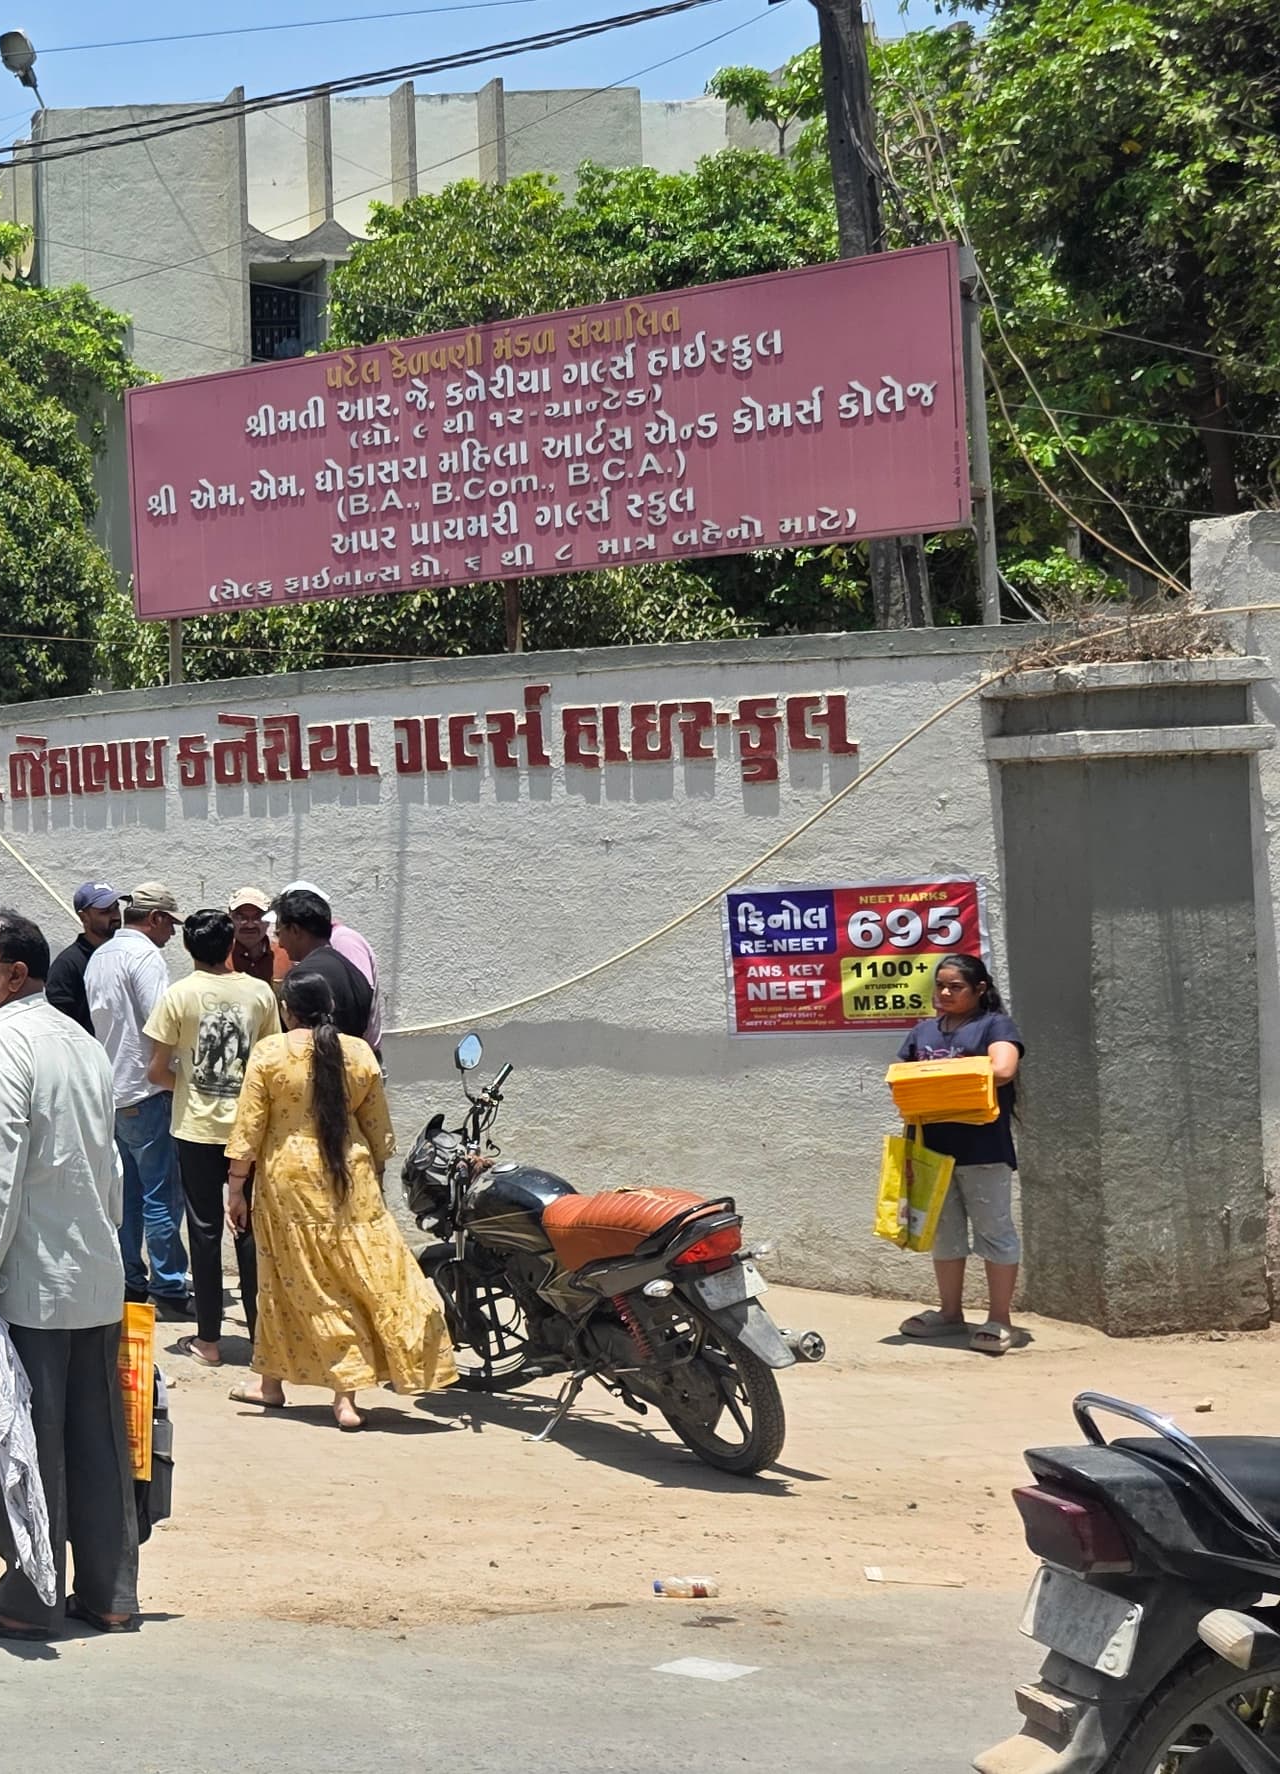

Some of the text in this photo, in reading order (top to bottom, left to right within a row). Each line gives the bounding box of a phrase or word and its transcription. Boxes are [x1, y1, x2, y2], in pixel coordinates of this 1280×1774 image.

[326, 304, 681, 390] પટેલ કેળવણી મંડળ સંચાલિત
[245, 396, 327, 438] શ્રીમતી
[337, 394, 399, 424] આર.
[405, 379, 435, 412] જે.
[445, 365, 552, 407] કનેરીયા
[442, 410, 476, 435] થી
[146, 484, 178, 518] શ્રી
[190, 479, 245, 512] એમ.
[250, 470, 306, 503] એમ.
[438, 438, 529, 475] મહિલા
[644, 409, 719, 447] એન્ડ
[732, 385, 825, 436] કોમર્સ
[837, 375, 938, 421] કોલેજ
[336, 449, 687, 522] (B.A., B.Com., B.C.A.)
[331, 526, 397, 556] અપર
[410, 500, 521, 548] પ્રાયમરી
[625, 486, 697, 527] સ્કુલ
[500, 543, 534, 568] થી
[597, 532, 658, 556] માત્ર
[671, 515, 765, 548] બહેનો
[176, 711, 380, 787] કનેરીયા
[859, 891, 948, 905] NEET MARKS
[740, 937, 828, 954] RE-NEET
[848, 906, 962, 949] 695
[746, 963, 825, 978] ANS. KEY
[747, 980, 826, 1001] NEET
[851, 961, 928, 978] 1100+
[853, 994, 927, 1011] M.B.B.S.
